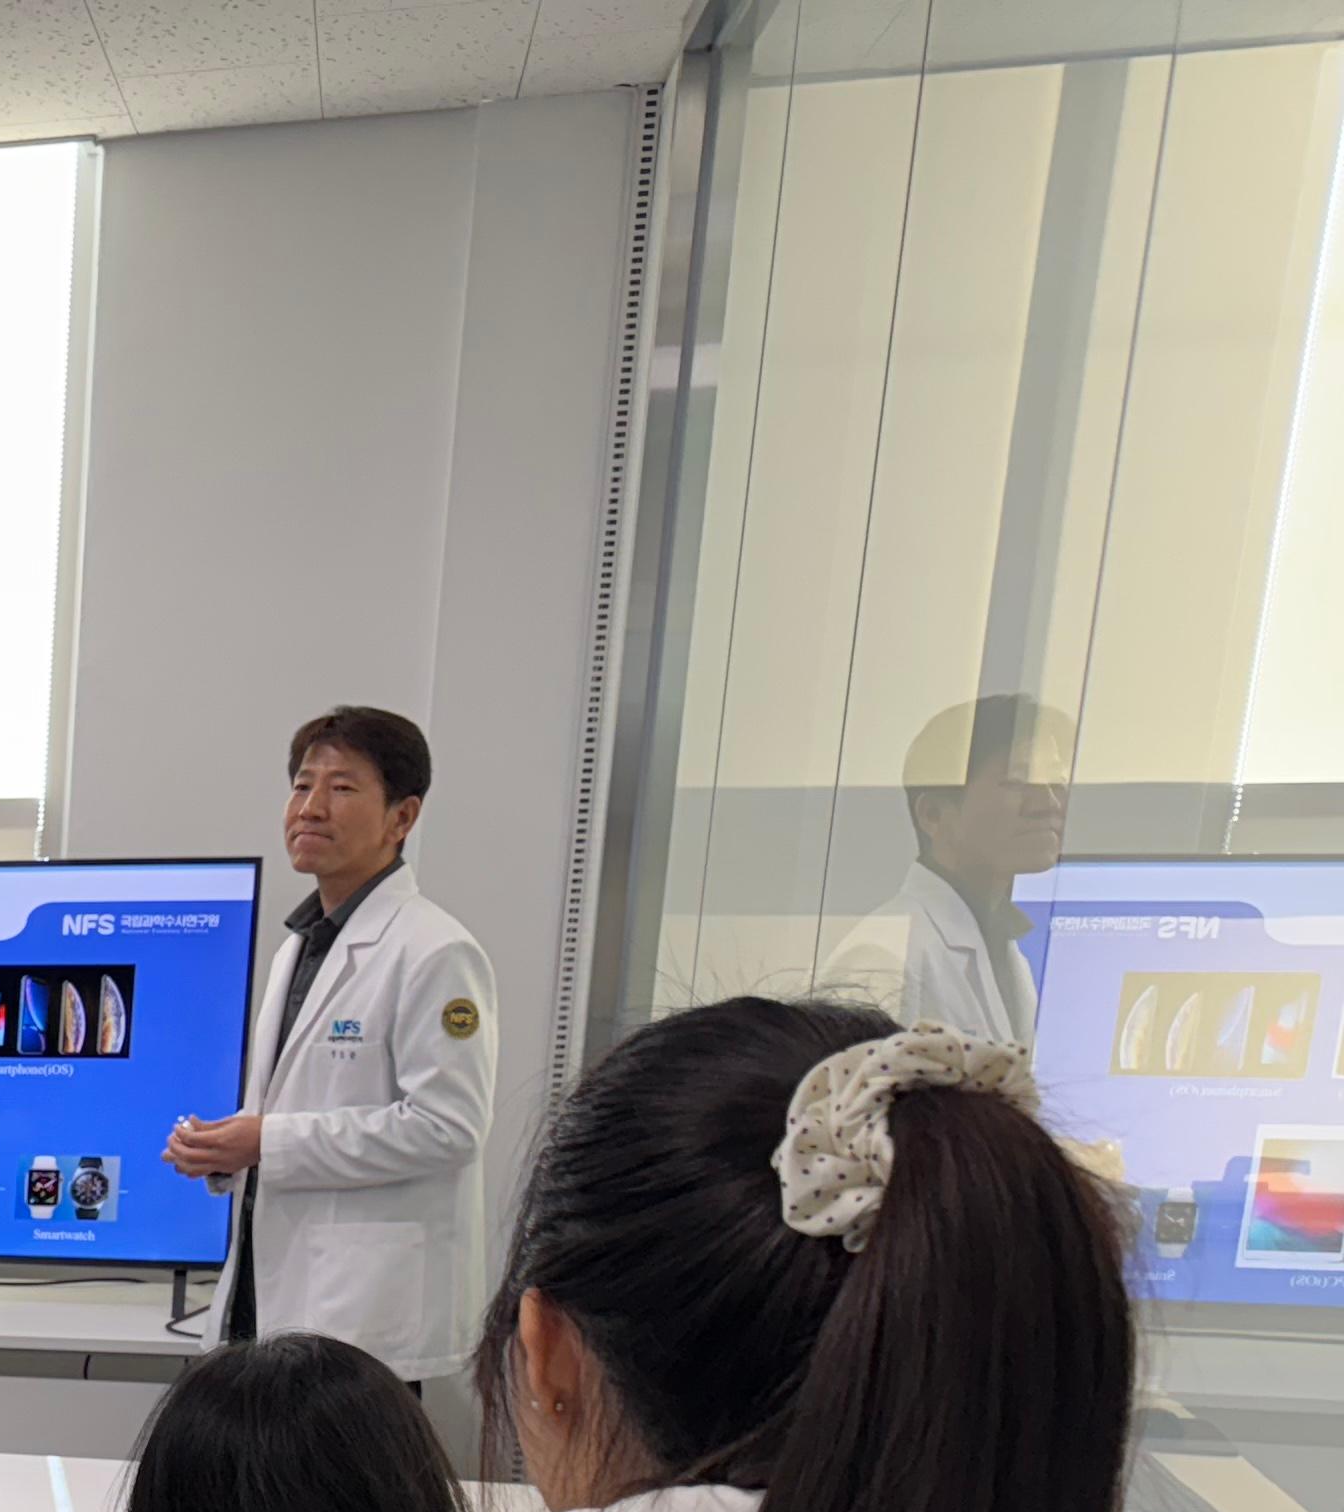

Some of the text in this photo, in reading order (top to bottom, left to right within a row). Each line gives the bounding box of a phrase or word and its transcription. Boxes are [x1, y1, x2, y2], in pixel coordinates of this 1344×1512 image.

[62, 913, 116, 937] NFS
[332, 1019, 361, 1035] NFS
[33, 1228, 96, 1241] Smartwatch
